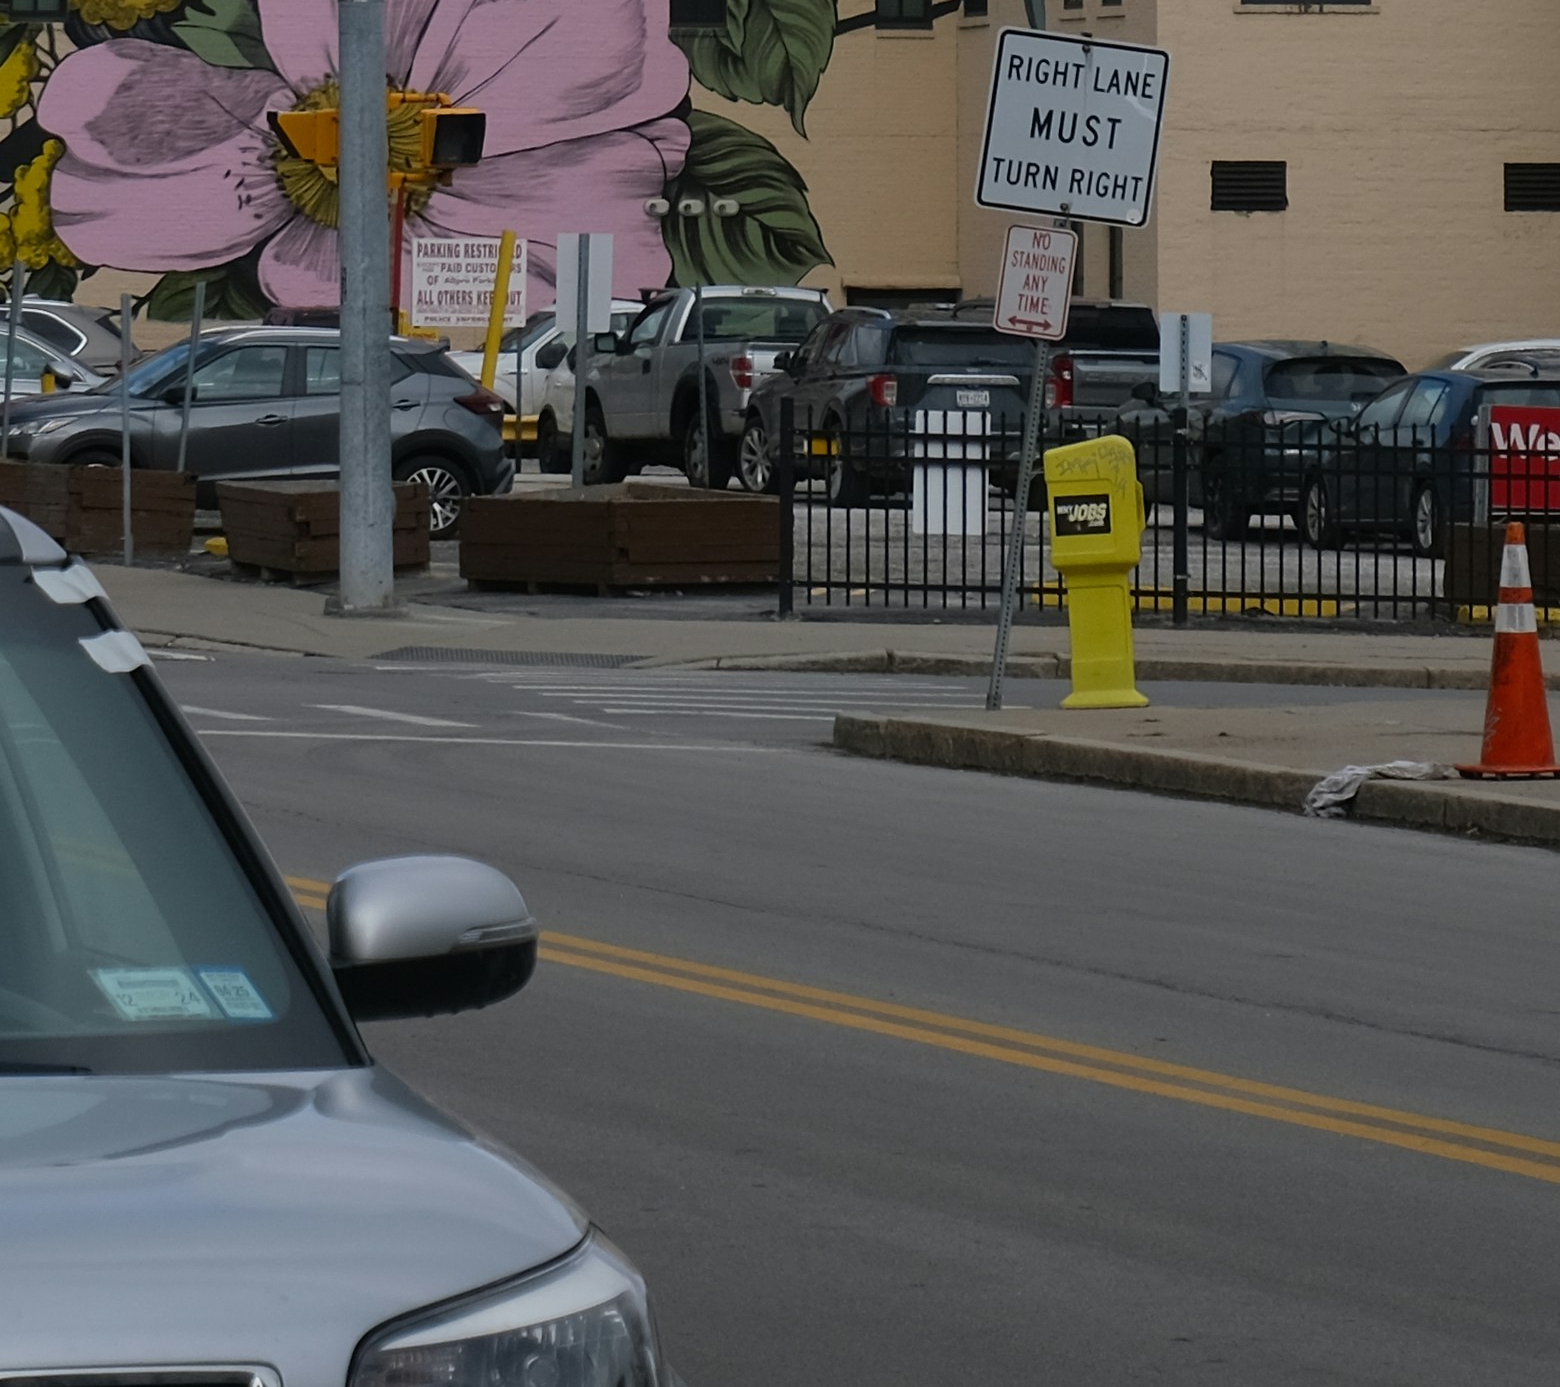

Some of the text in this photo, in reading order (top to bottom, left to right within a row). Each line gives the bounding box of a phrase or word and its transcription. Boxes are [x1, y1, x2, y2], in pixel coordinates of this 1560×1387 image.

[1007, 54, 1155, 99] RIGHT LANE
[1030, 107, 1122, 149] MUST
[993, 157, 1143, 202] TURN RIGHT
[417, 243, 460, 258] PARKING
[1032, 232, 1051, 250] NO
[440, 263, 462, 273] PAID
[1011, 250, 1066, 274] STANDING
[427, 275, 438, 285] OF
[1023, 273, 1048, 293] ANY
[417, 290, 434, 305] ALL
[437, 290, 473, 306] OTHERS
[477, 291, 495, 305] KEE
[1018, 293, 1050, 315] TIME
[1068, 503, 1107, 522] JOBS
